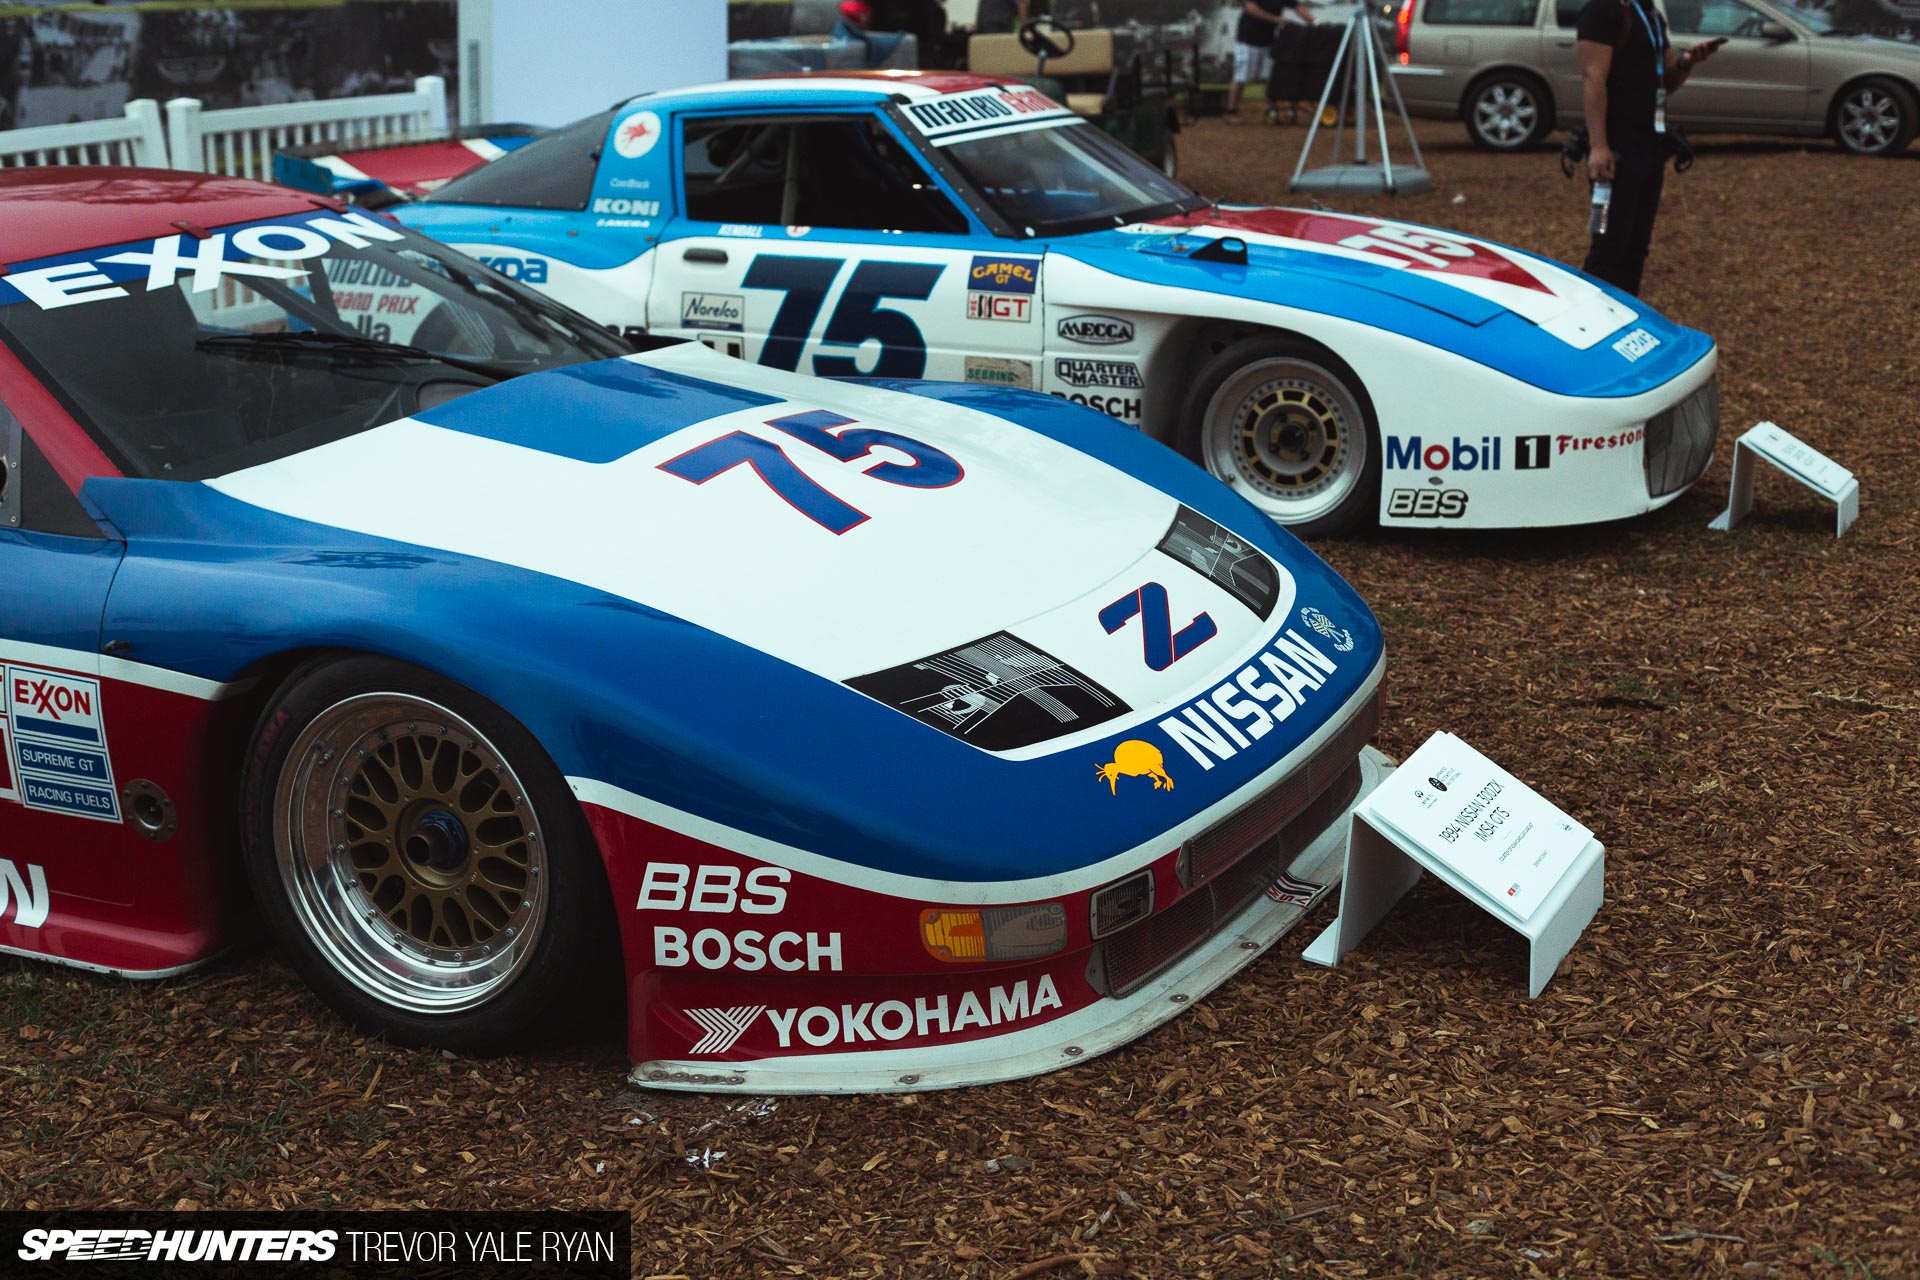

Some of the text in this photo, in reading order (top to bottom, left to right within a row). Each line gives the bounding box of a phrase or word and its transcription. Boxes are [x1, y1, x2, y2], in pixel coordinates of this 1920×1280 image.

[593, 198, 660, 217] KONI
[2, 211, 405, 311] EXXON
[1337, 225, 1476, 269] 75
[972, 262, 1034, 283] CAMEL
[684, 295, 739, 320] Norelco
[740, 253, 948, 380] 75
[993, 297, 1029, 318] GT
[1059, 322, 1133, 340] MECCA
[1058, 361, 1137, 378] QUARTER
[1072, 373, 1141, 387] MASTER
[1386, 435, 1501, 471] Mobil
[654, 409, 966, 536] 75
[1387, 488, 1469, 518] BBS
[1098, 581, 1218, 672] Z
[14, 678, 91, 720] EXXON
[1157, 628, 1338, 771] NISSAN
[22, 749, 95, 772] SUPREME GT
[28, 784, 111, 810] RACING FUELS
[1438, 778, 1505, 844] 1994 NISSAN 300ZX
[1473, 806, 1511, 843] IMSA GTS
[636, 862, 792, 915] BBS
[653, 926, 843, 972] BOSCH
[765, 973, 1063, 1048] YOKOHAMA
